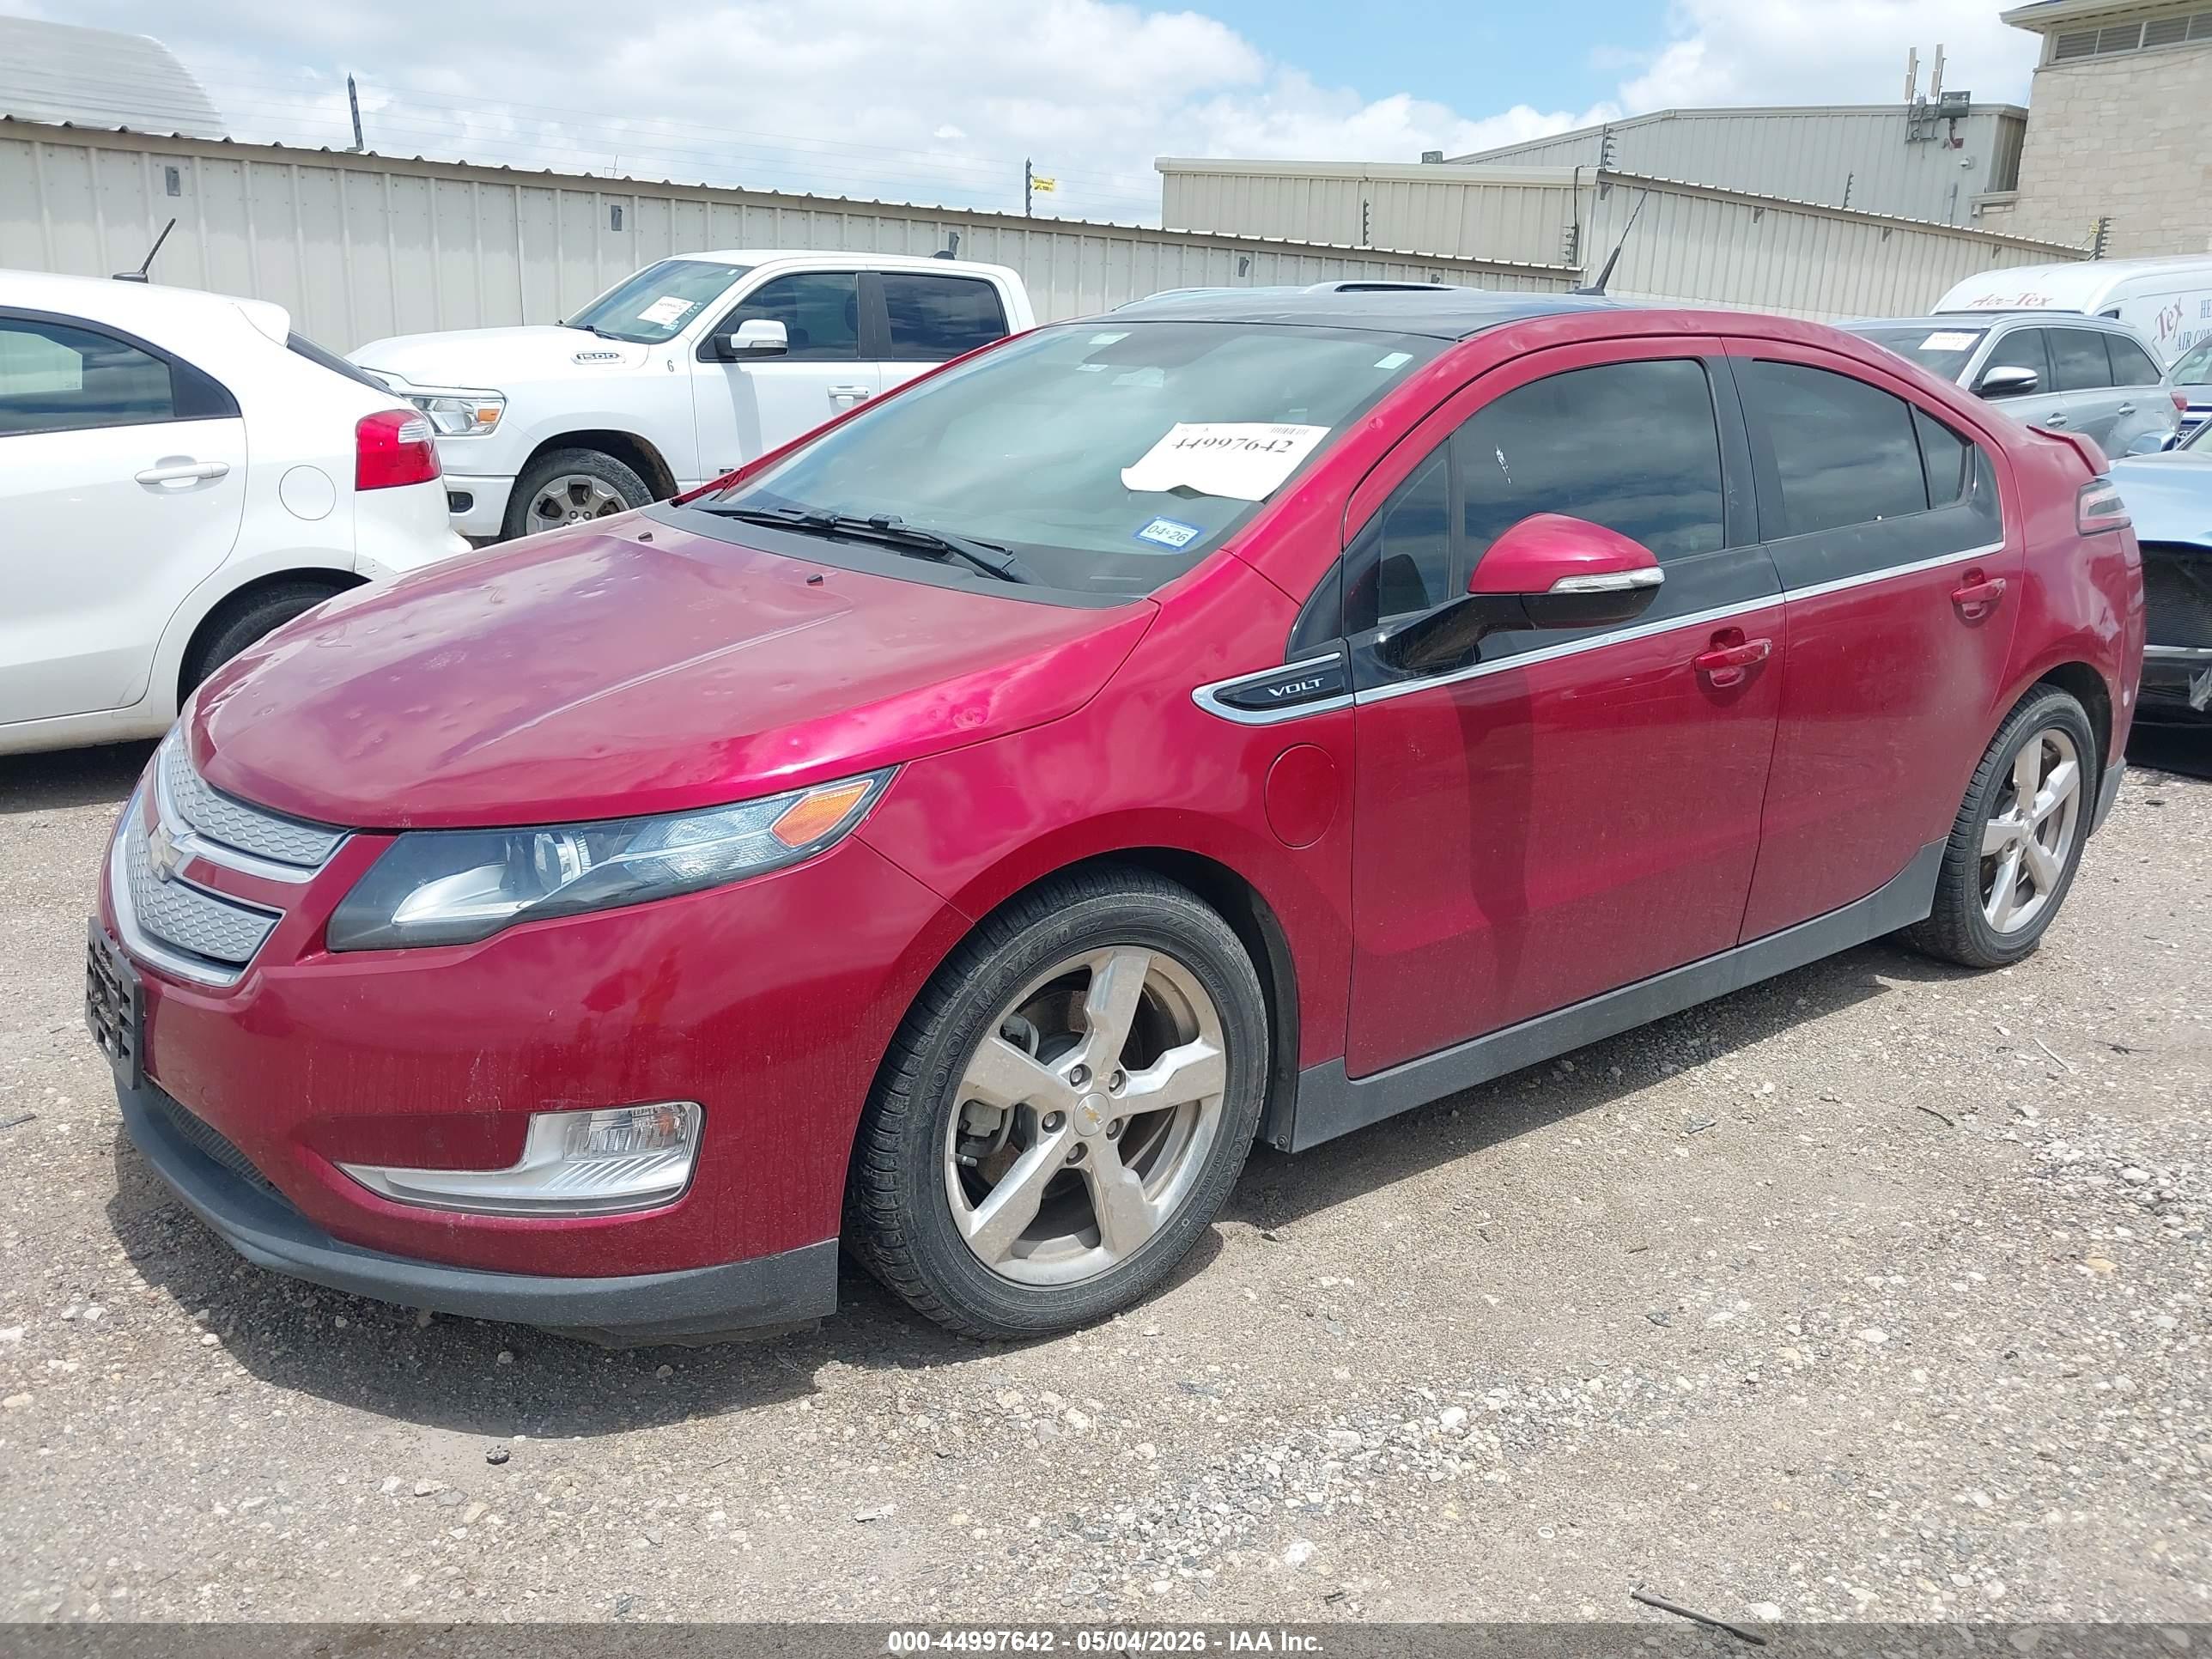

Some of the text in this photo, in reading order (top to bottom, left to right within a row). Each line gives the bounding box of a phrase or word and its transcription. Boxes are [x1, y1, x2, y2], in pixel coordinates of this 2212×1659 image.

[1966, 293, 2055, 308] Air-Tex
[2175, 331, 2192, 351] AIR
[577, 352, 618, 361] 1500
[667, 359, 675, 373] 6
[1171, 437, 1295, 453] 44997642
[1267, 678, 1325, 697] VOLT
[924, 975, 1008, 1101] YOKOHAMA
